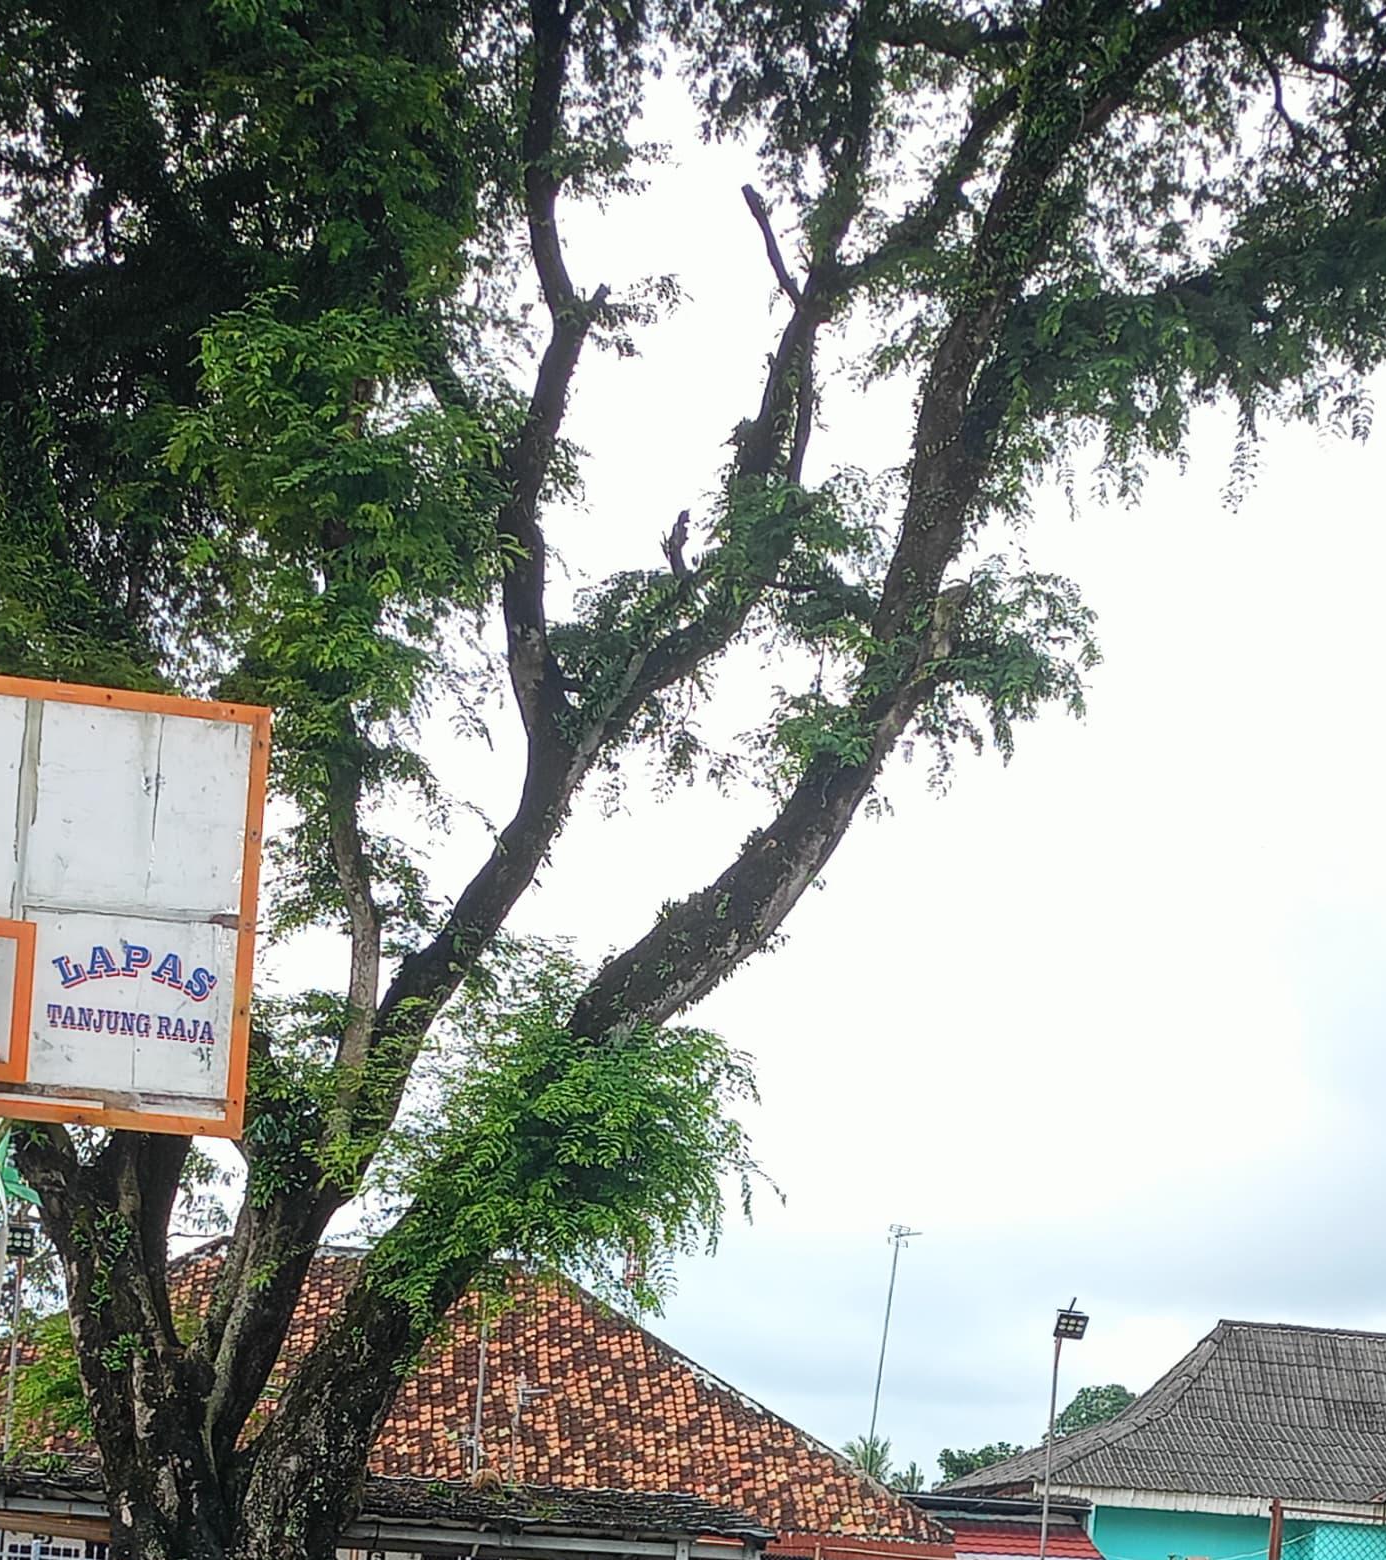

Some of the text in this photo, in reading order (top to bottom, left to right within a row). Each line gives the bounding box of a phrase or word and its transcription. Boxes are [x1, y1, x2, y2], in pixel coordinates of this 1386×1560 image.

[51, 944, 218, 1002] LAPAS
[47, 1003, 215, 1045] TANJUNG RAJA
